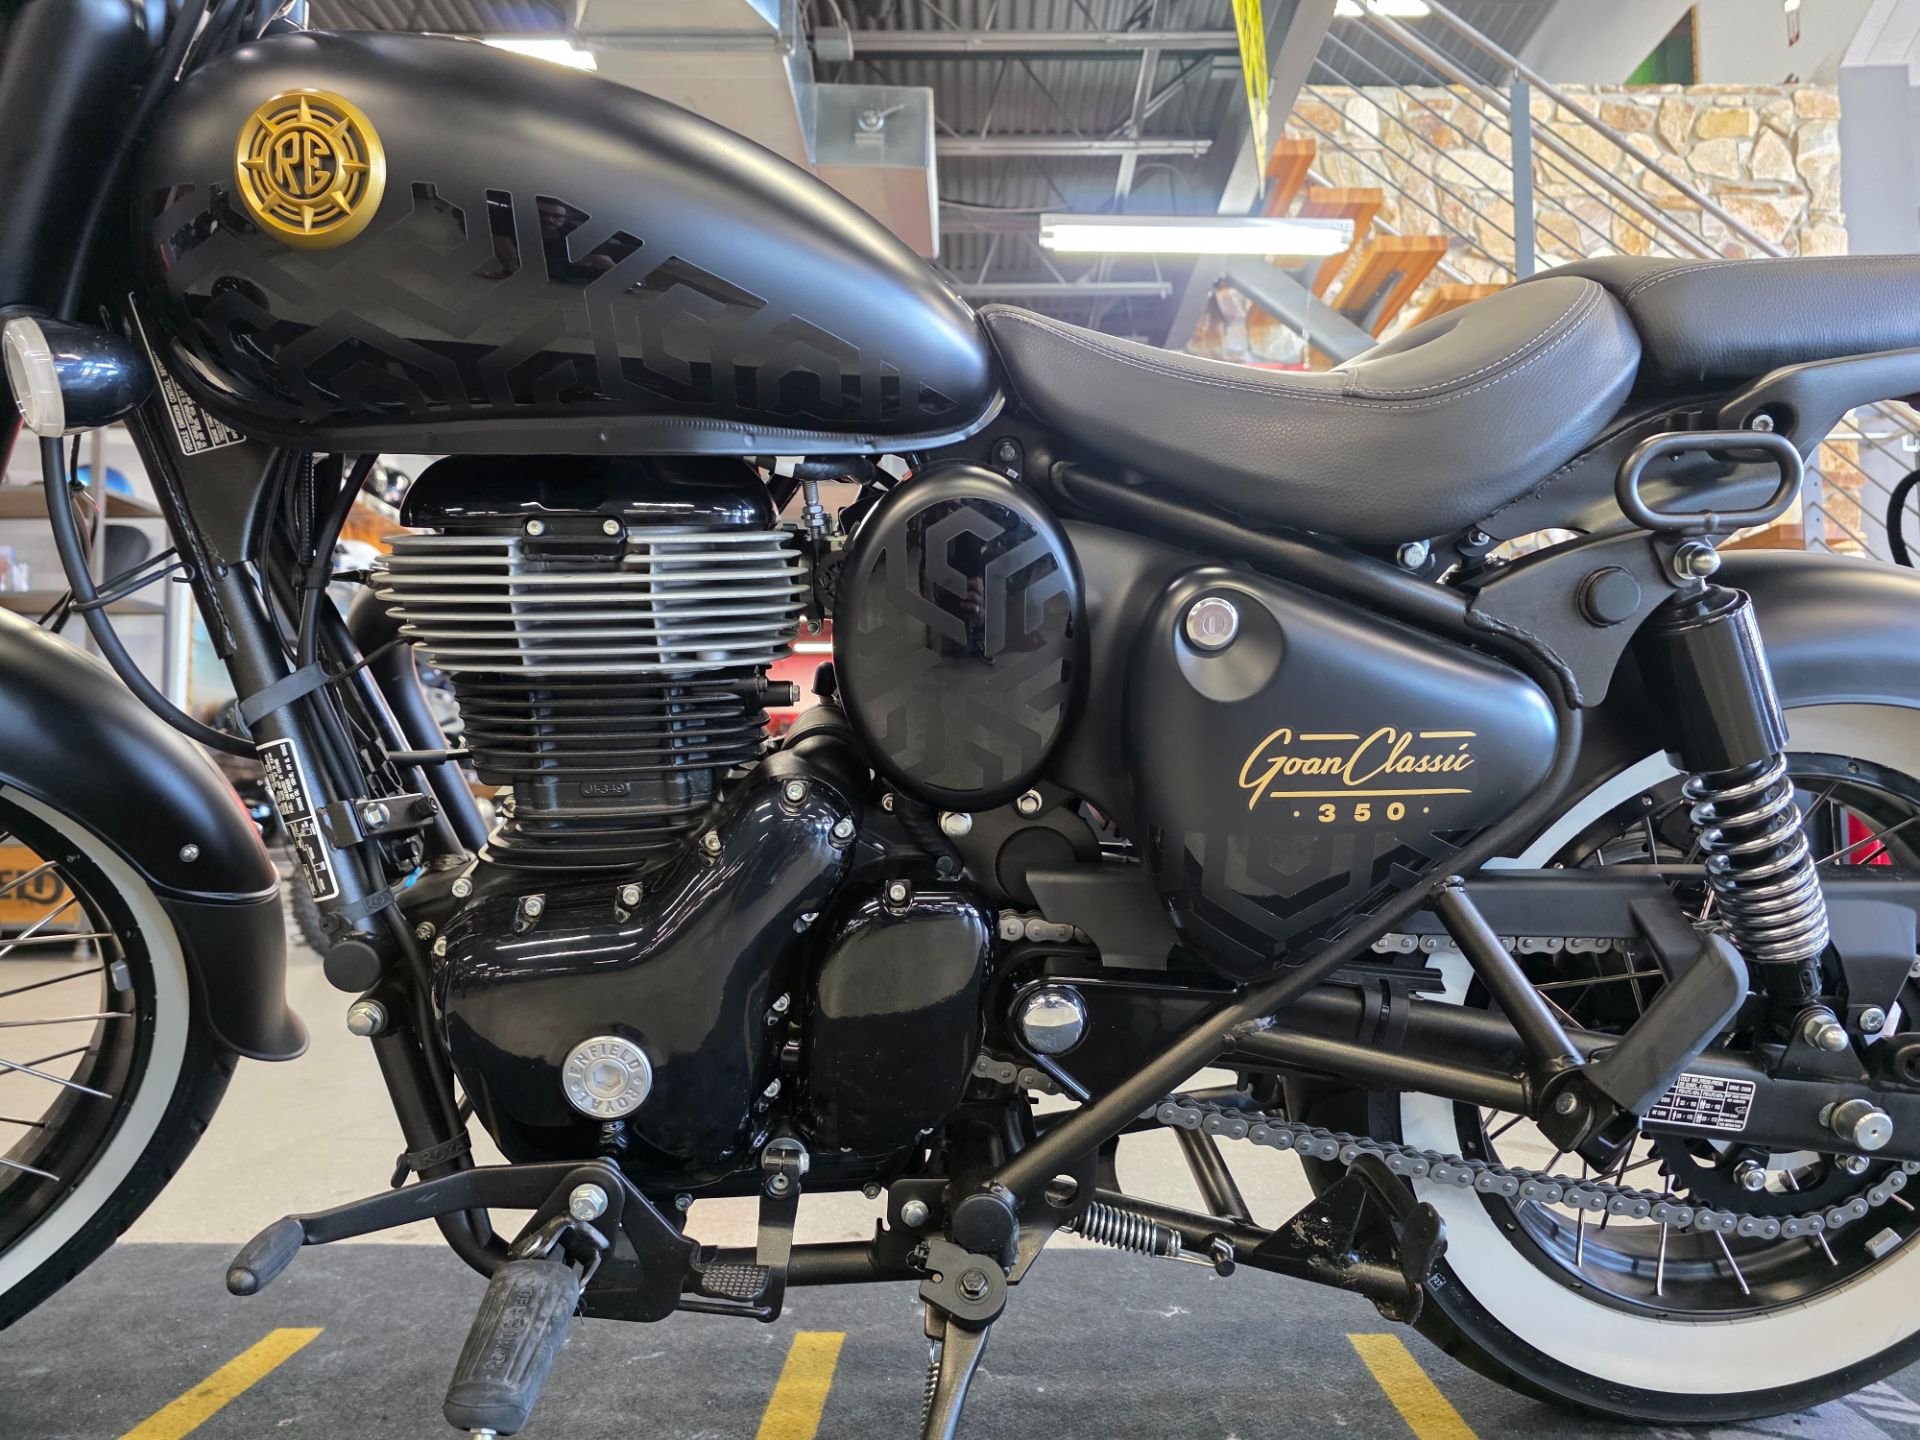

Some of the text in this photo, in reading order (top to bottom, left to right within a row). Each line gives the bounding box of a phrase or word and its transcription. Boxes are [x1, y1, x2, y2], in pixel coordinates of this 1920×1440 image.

[274, 131, 333, 195] RE
[164, 379, 177, 403] CONTROL
[181, 430, 193, 452] VEHICLE
[1239, 727, 1475, 811] Goan Classic
[1318, 802, 1405, 822] 350
[568, 1043, 641, 1078] ENFIELD
[579, 1087, 639, 1112] ROYAL
